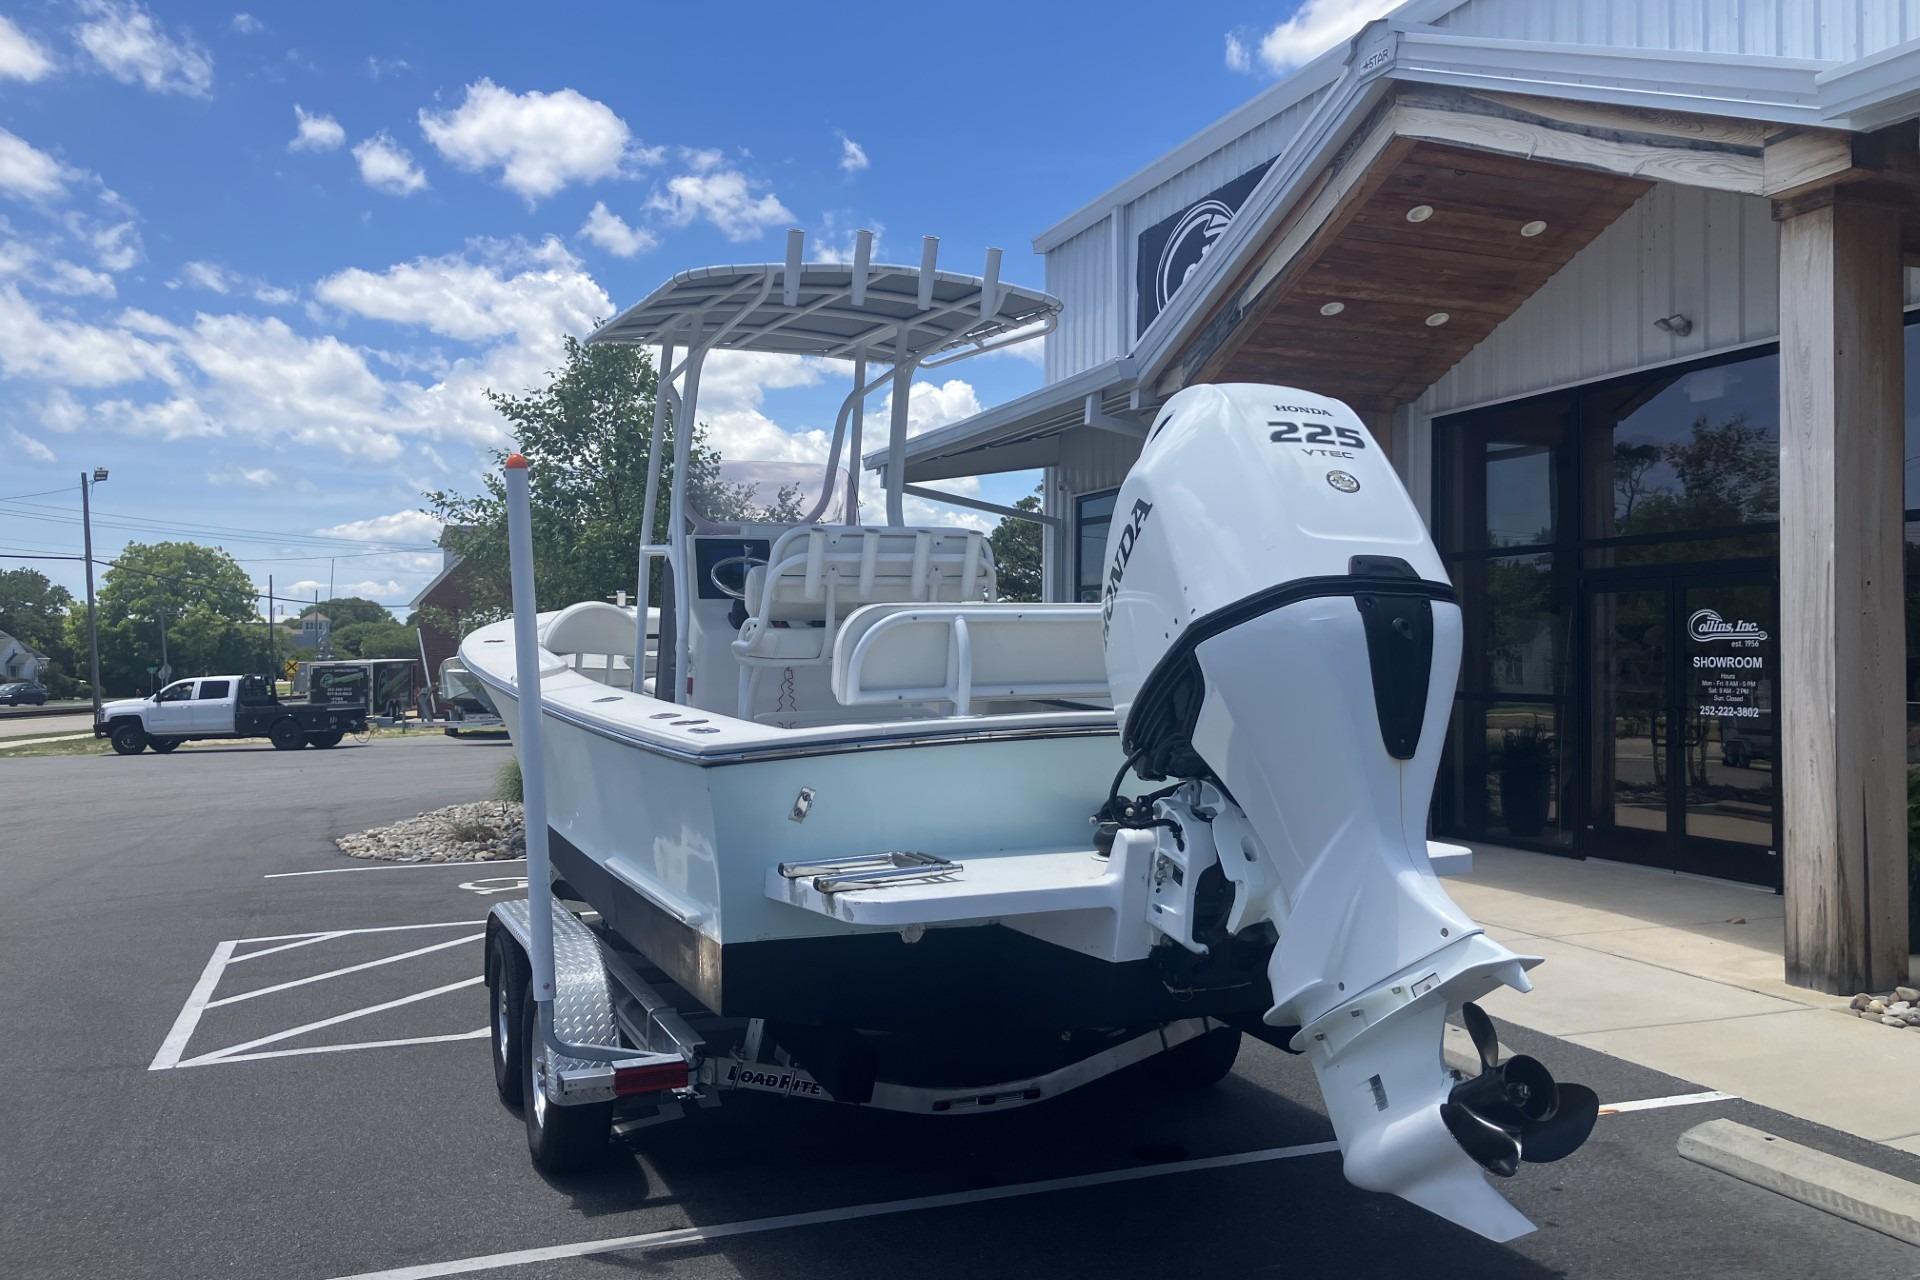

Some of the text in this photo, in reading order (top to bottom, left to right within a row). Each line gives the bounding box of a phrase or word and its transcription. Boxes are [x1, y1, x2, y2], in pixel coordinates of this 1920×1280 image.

[1369, 48, 1389, 69] STAR
[1273, 404, 1333, 417] HONDA
[1266, 421, 1366, 450] 225
[1301, 448, 1355, 460] VTEC
[1735, 620, 1759, 632] Inc.
[1745, 640, 1760, 648] 1956
[1692, 656, 1763, 669] SHOWROOM
[1699, 705, 1759, 718] 252-222-3802
